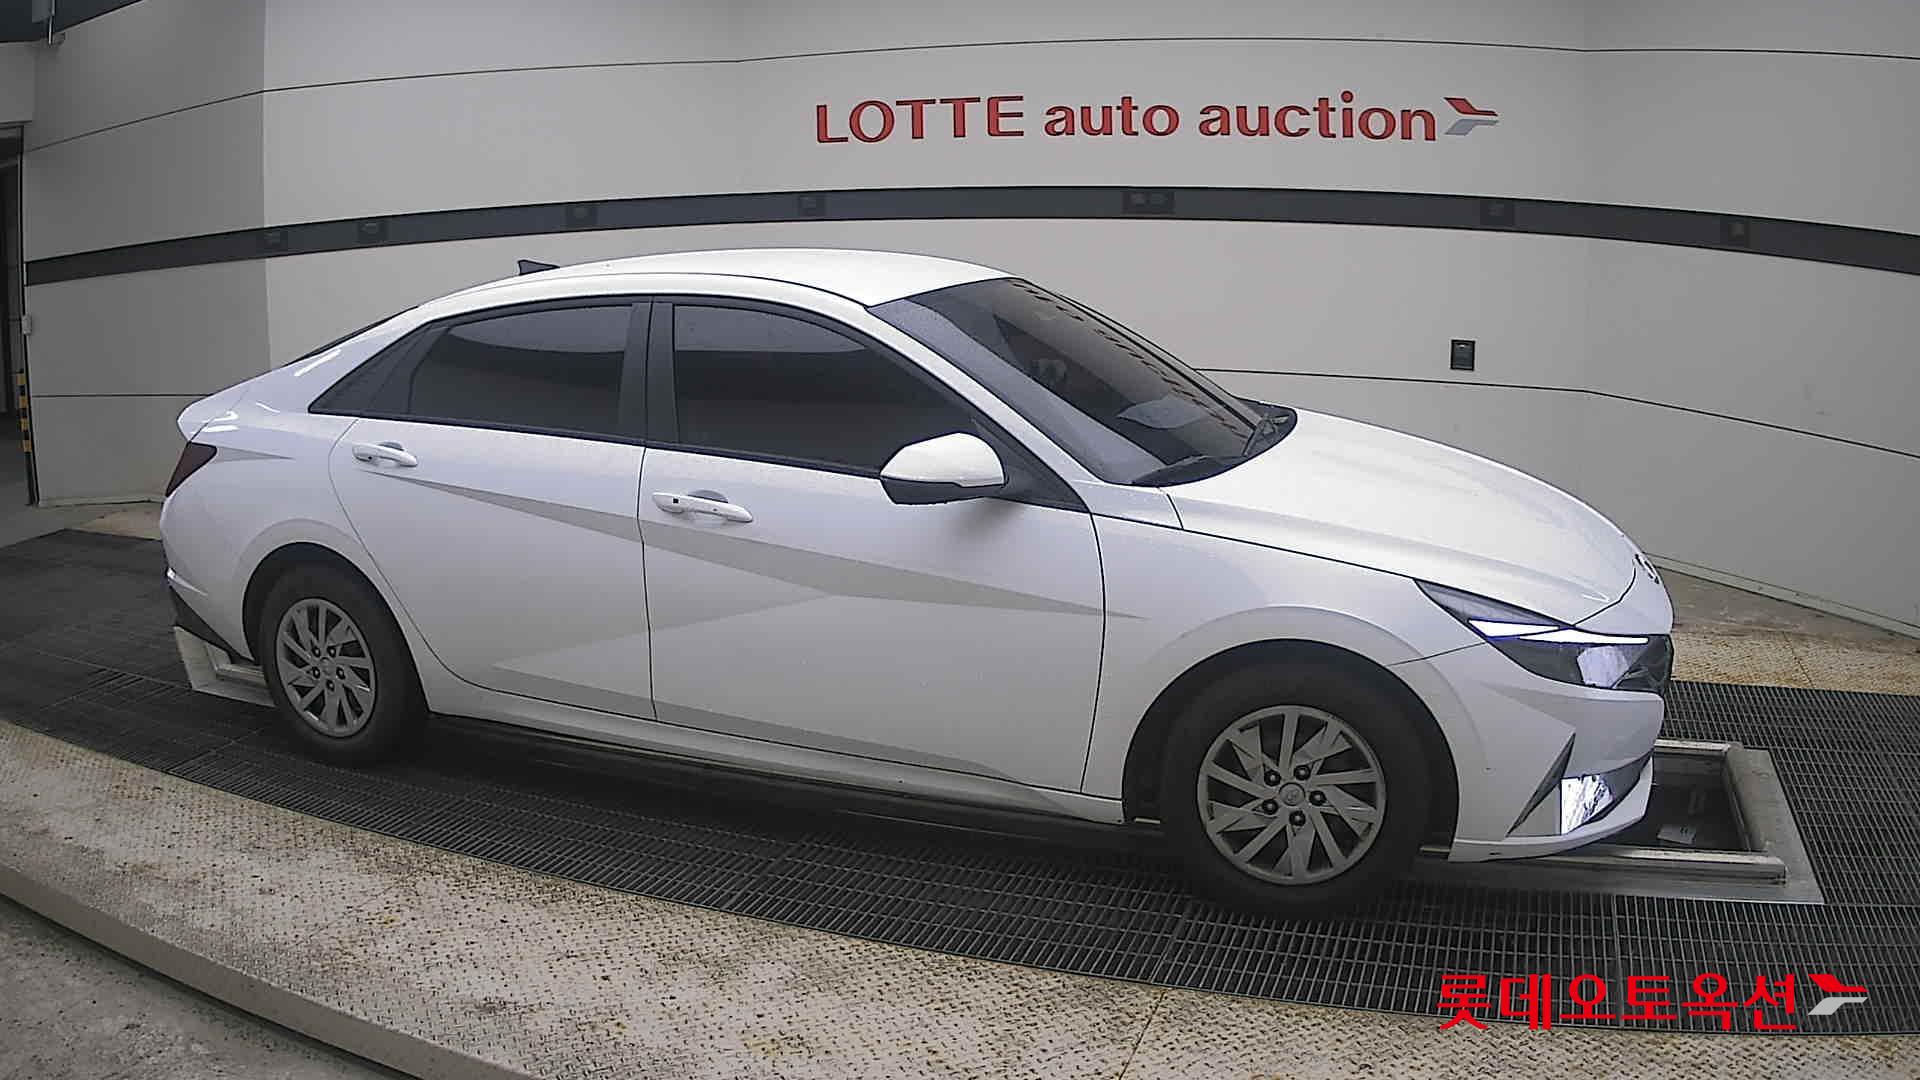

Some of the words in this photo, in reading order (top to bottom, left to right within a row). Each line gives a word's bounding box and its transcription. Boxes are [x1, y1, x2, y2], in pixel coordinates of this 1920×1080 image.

[816, 95, 1024, 143] LOTTE
[1044, 96, 1181, 137] auto
[1199, 90, 1437, 141] auction
